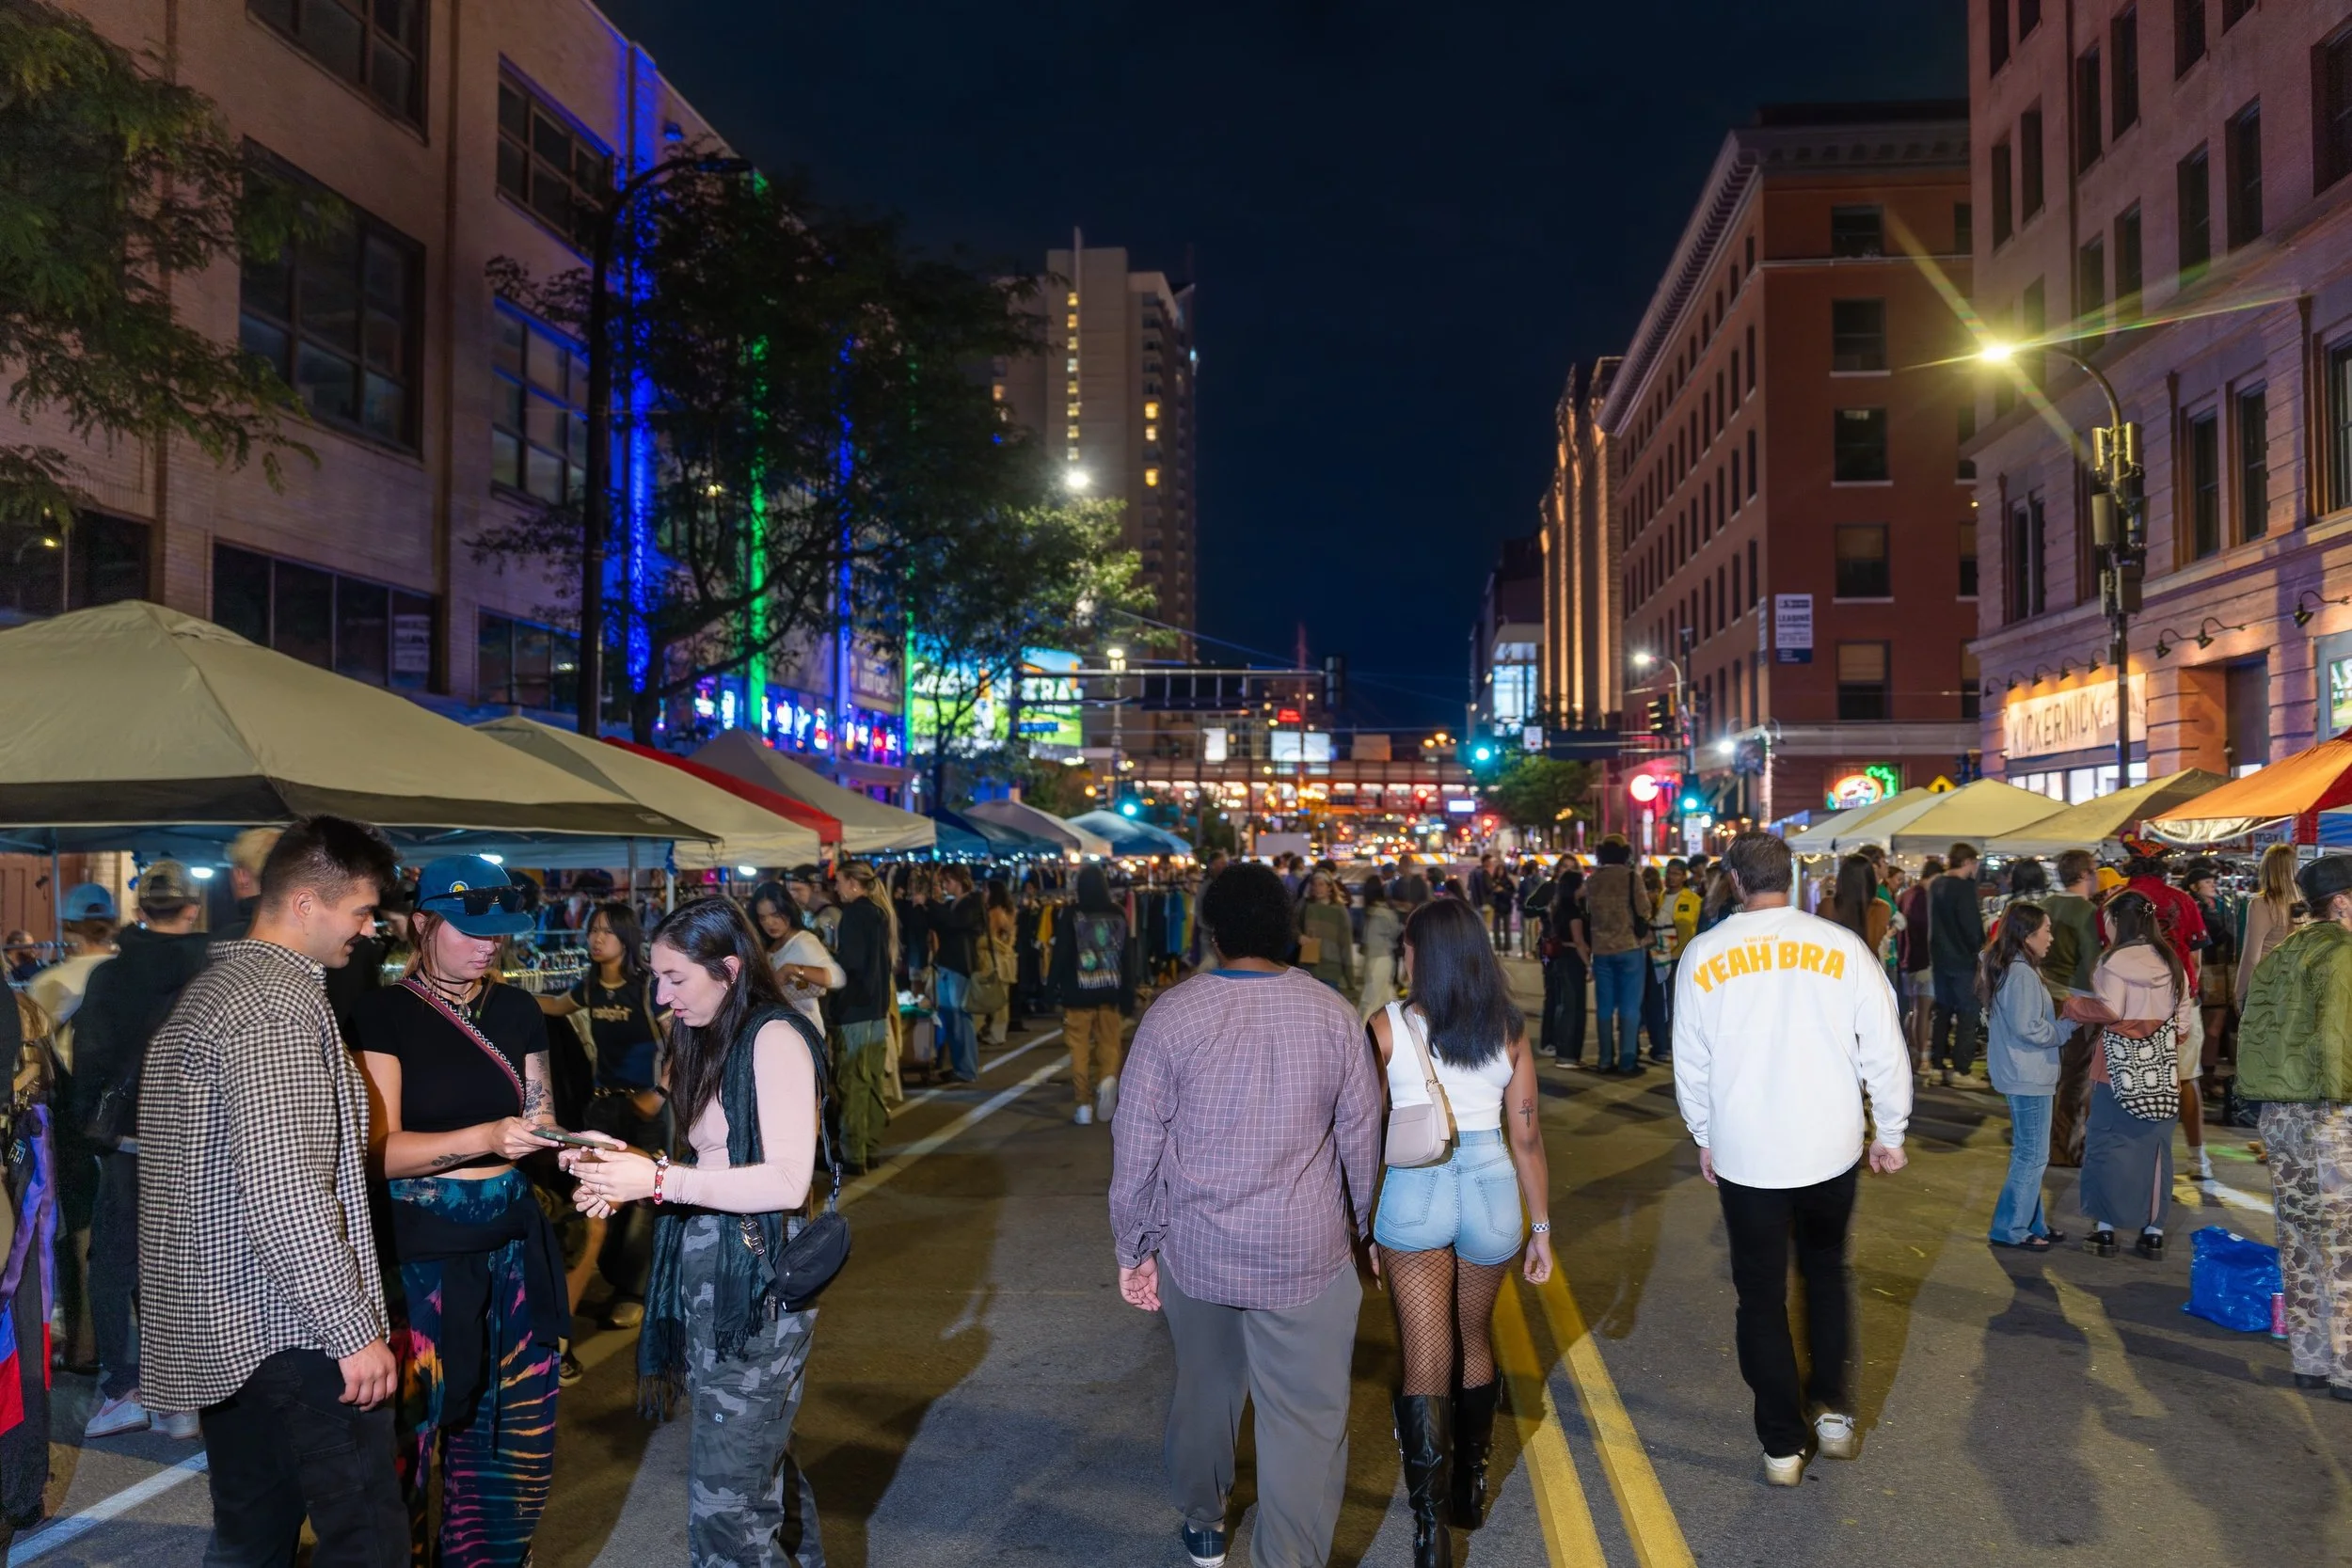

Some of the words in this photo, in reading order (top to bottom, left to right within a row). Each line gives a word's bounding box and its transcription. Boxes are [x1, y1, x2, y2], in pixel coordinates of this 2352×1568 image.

[2013, 689, 2101, 754] KICKERNICK
[1693, 942, 1772, 993] YEAH
[1778, 941, 1846, 980] BRA
